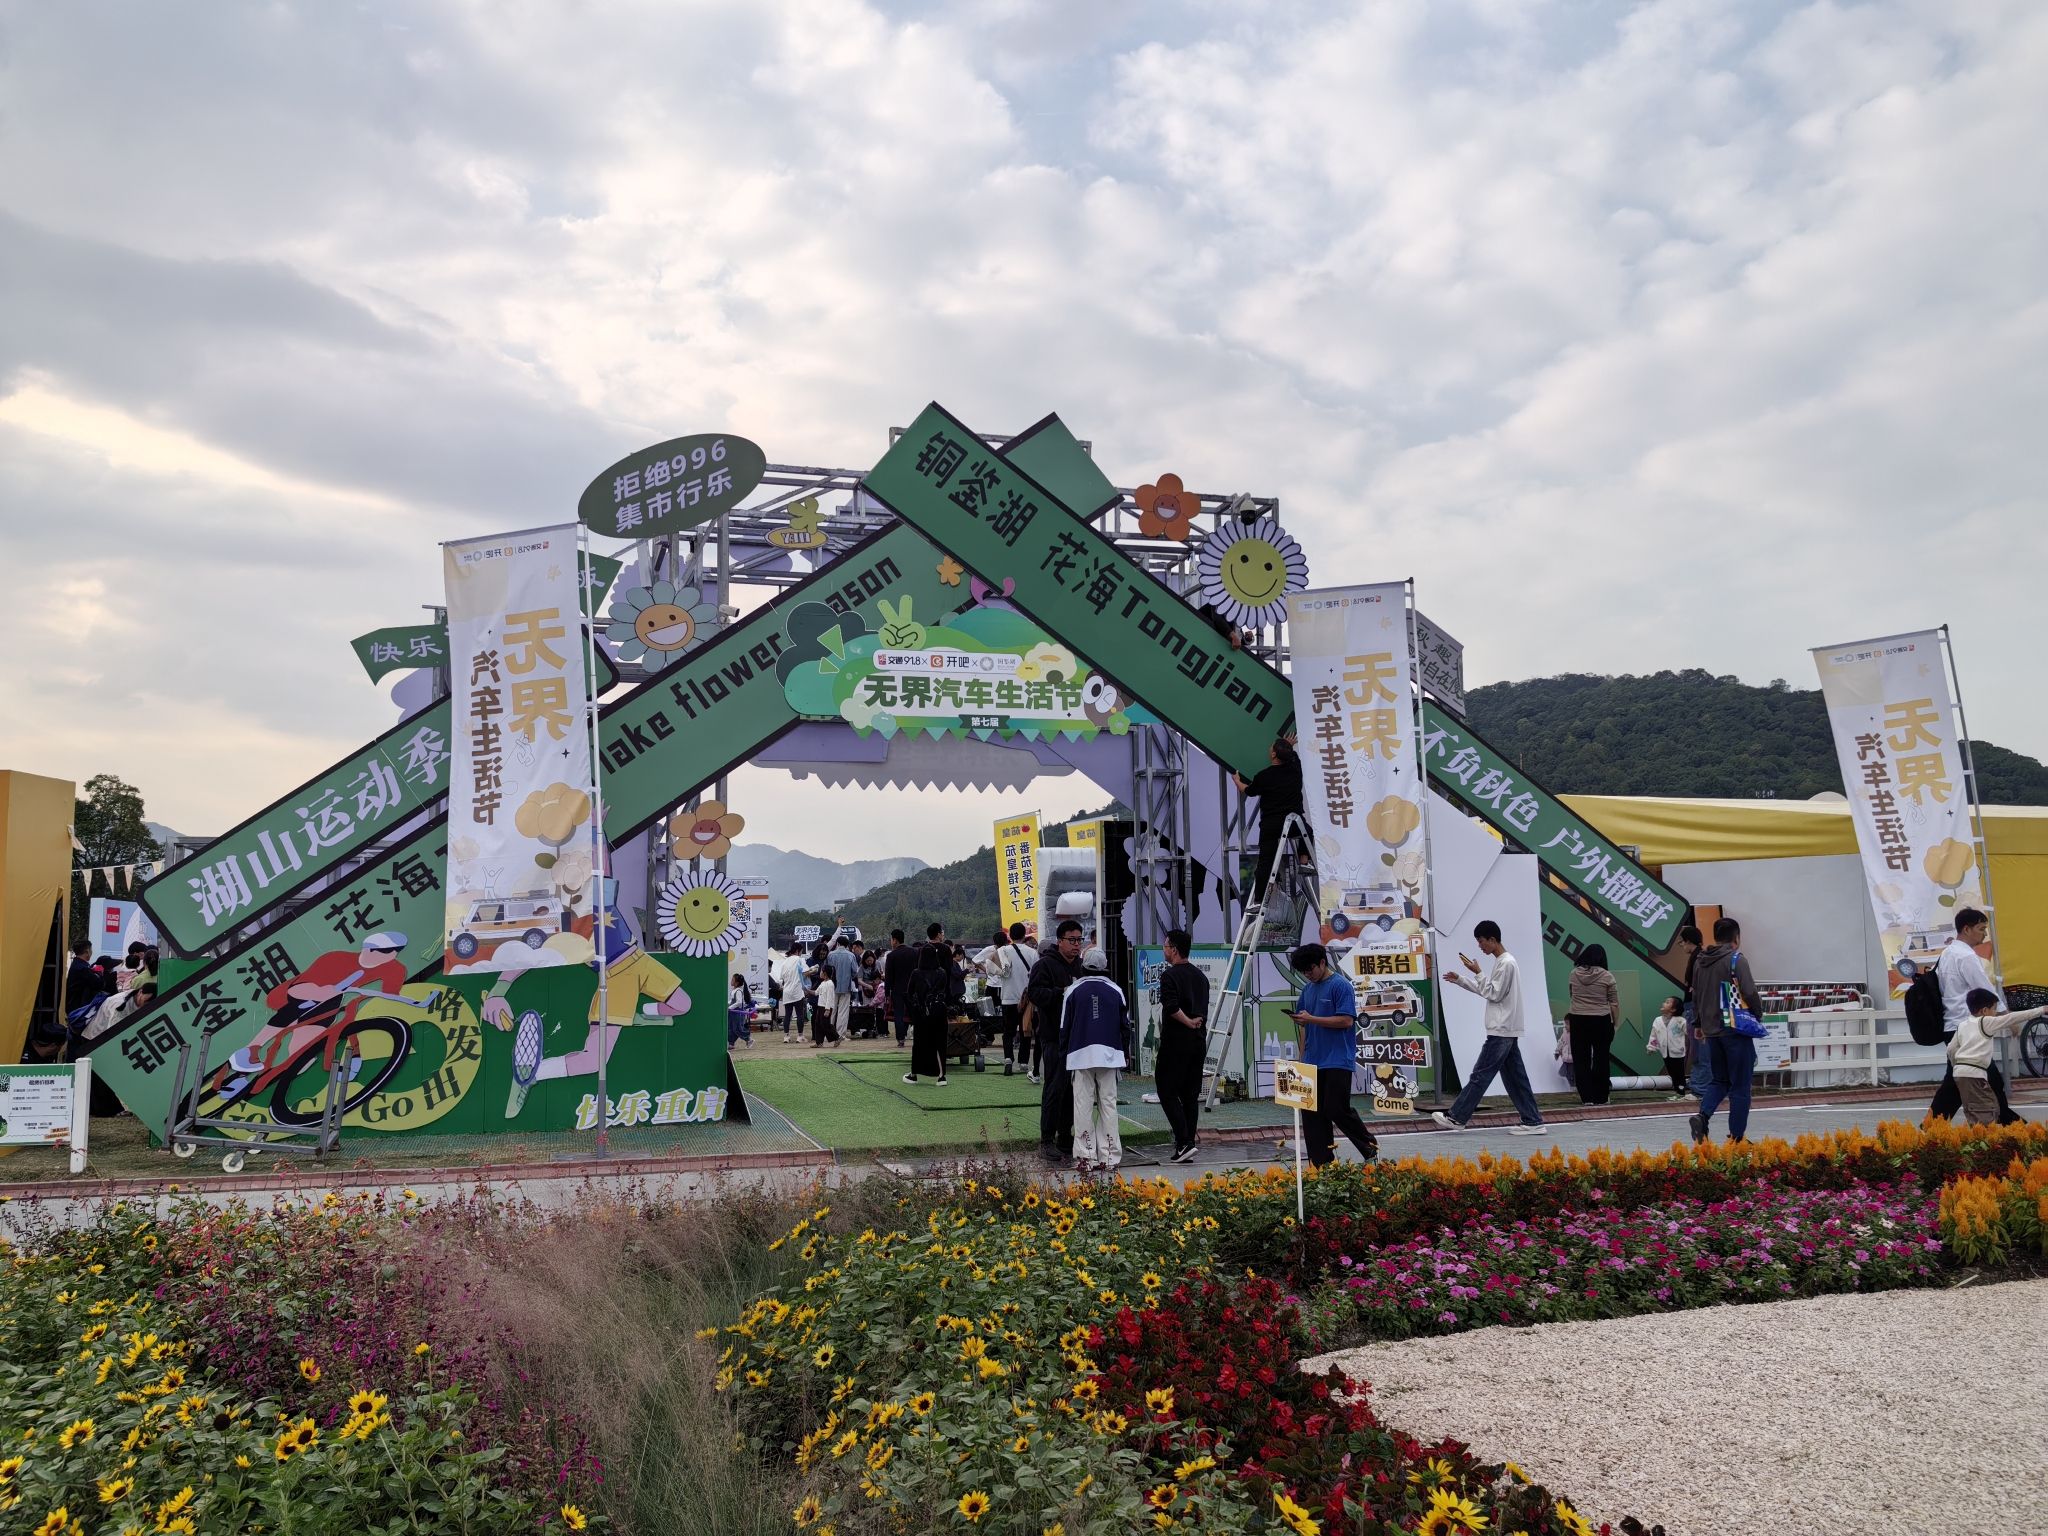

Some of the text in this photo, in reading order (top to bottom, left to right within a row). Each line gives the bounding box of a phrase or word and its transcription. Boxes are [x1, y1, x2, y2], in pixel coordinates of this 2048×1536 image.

[613, 439, 727, 503] 拒绝996
[915, 430, 1039, 547] 铜鉴湖
[615, 467, 734, 533] 集市行乐
[888, 656, 970, 668] 交通91.8 开吧
[863, 674, 1084, 711] 无界汽车生活节
[971, 717, 999, 727] 第七届
[187, 725, 451, 927] 湖山运动季
[1418, 720, 1675, 928] 不负秋色 户外撒野
[121, 941, 300, 1075] 铜鉴湖
[670, 631, 785, 720] flower
[1359, 954, 1410, 975] 服务台
[1355, 1043, 1403, 1060] 交通91.8
[360, 1092, 414, 1124] Go
[577, 1087, 727, 1129] 快乐重启
[1376, 1098, 1410, 1111] come
